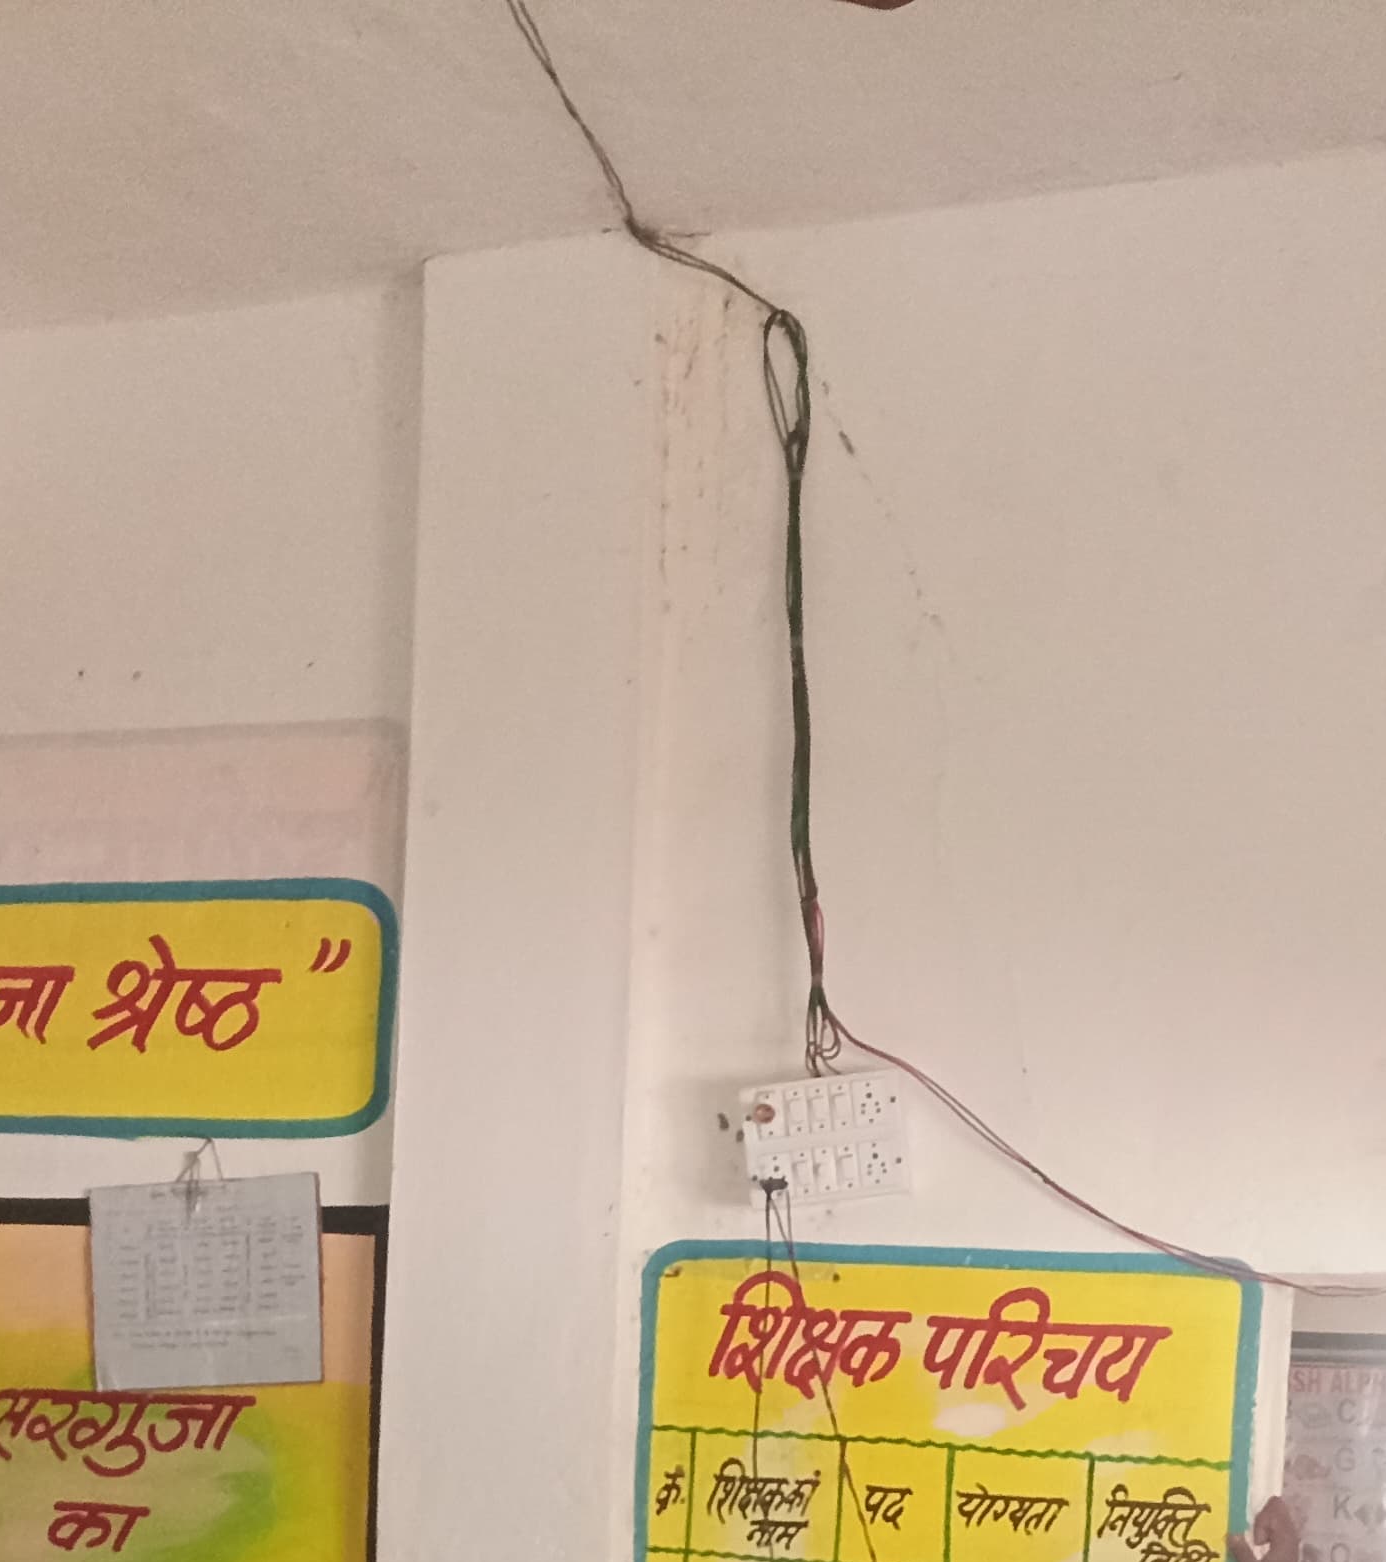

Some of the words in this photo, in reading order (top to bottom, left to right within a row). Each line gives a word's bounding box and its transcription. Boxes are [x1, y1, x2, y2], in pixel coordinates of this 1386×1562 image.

[709, 1271, 912, 1399] शिक्षक
[924, 1287, 1173, 1410] परिचय
[47, 1500, 150, 1552] का
[865, 1485, 912, 1530] पद
[956, 1482, 1069, 1535] योग्यता
[1097, 1484, 1211, 1549] नियुक्ति
[1333, 1495, 1353, 1521] K
[747, 1520, 808, 1550] नाम
